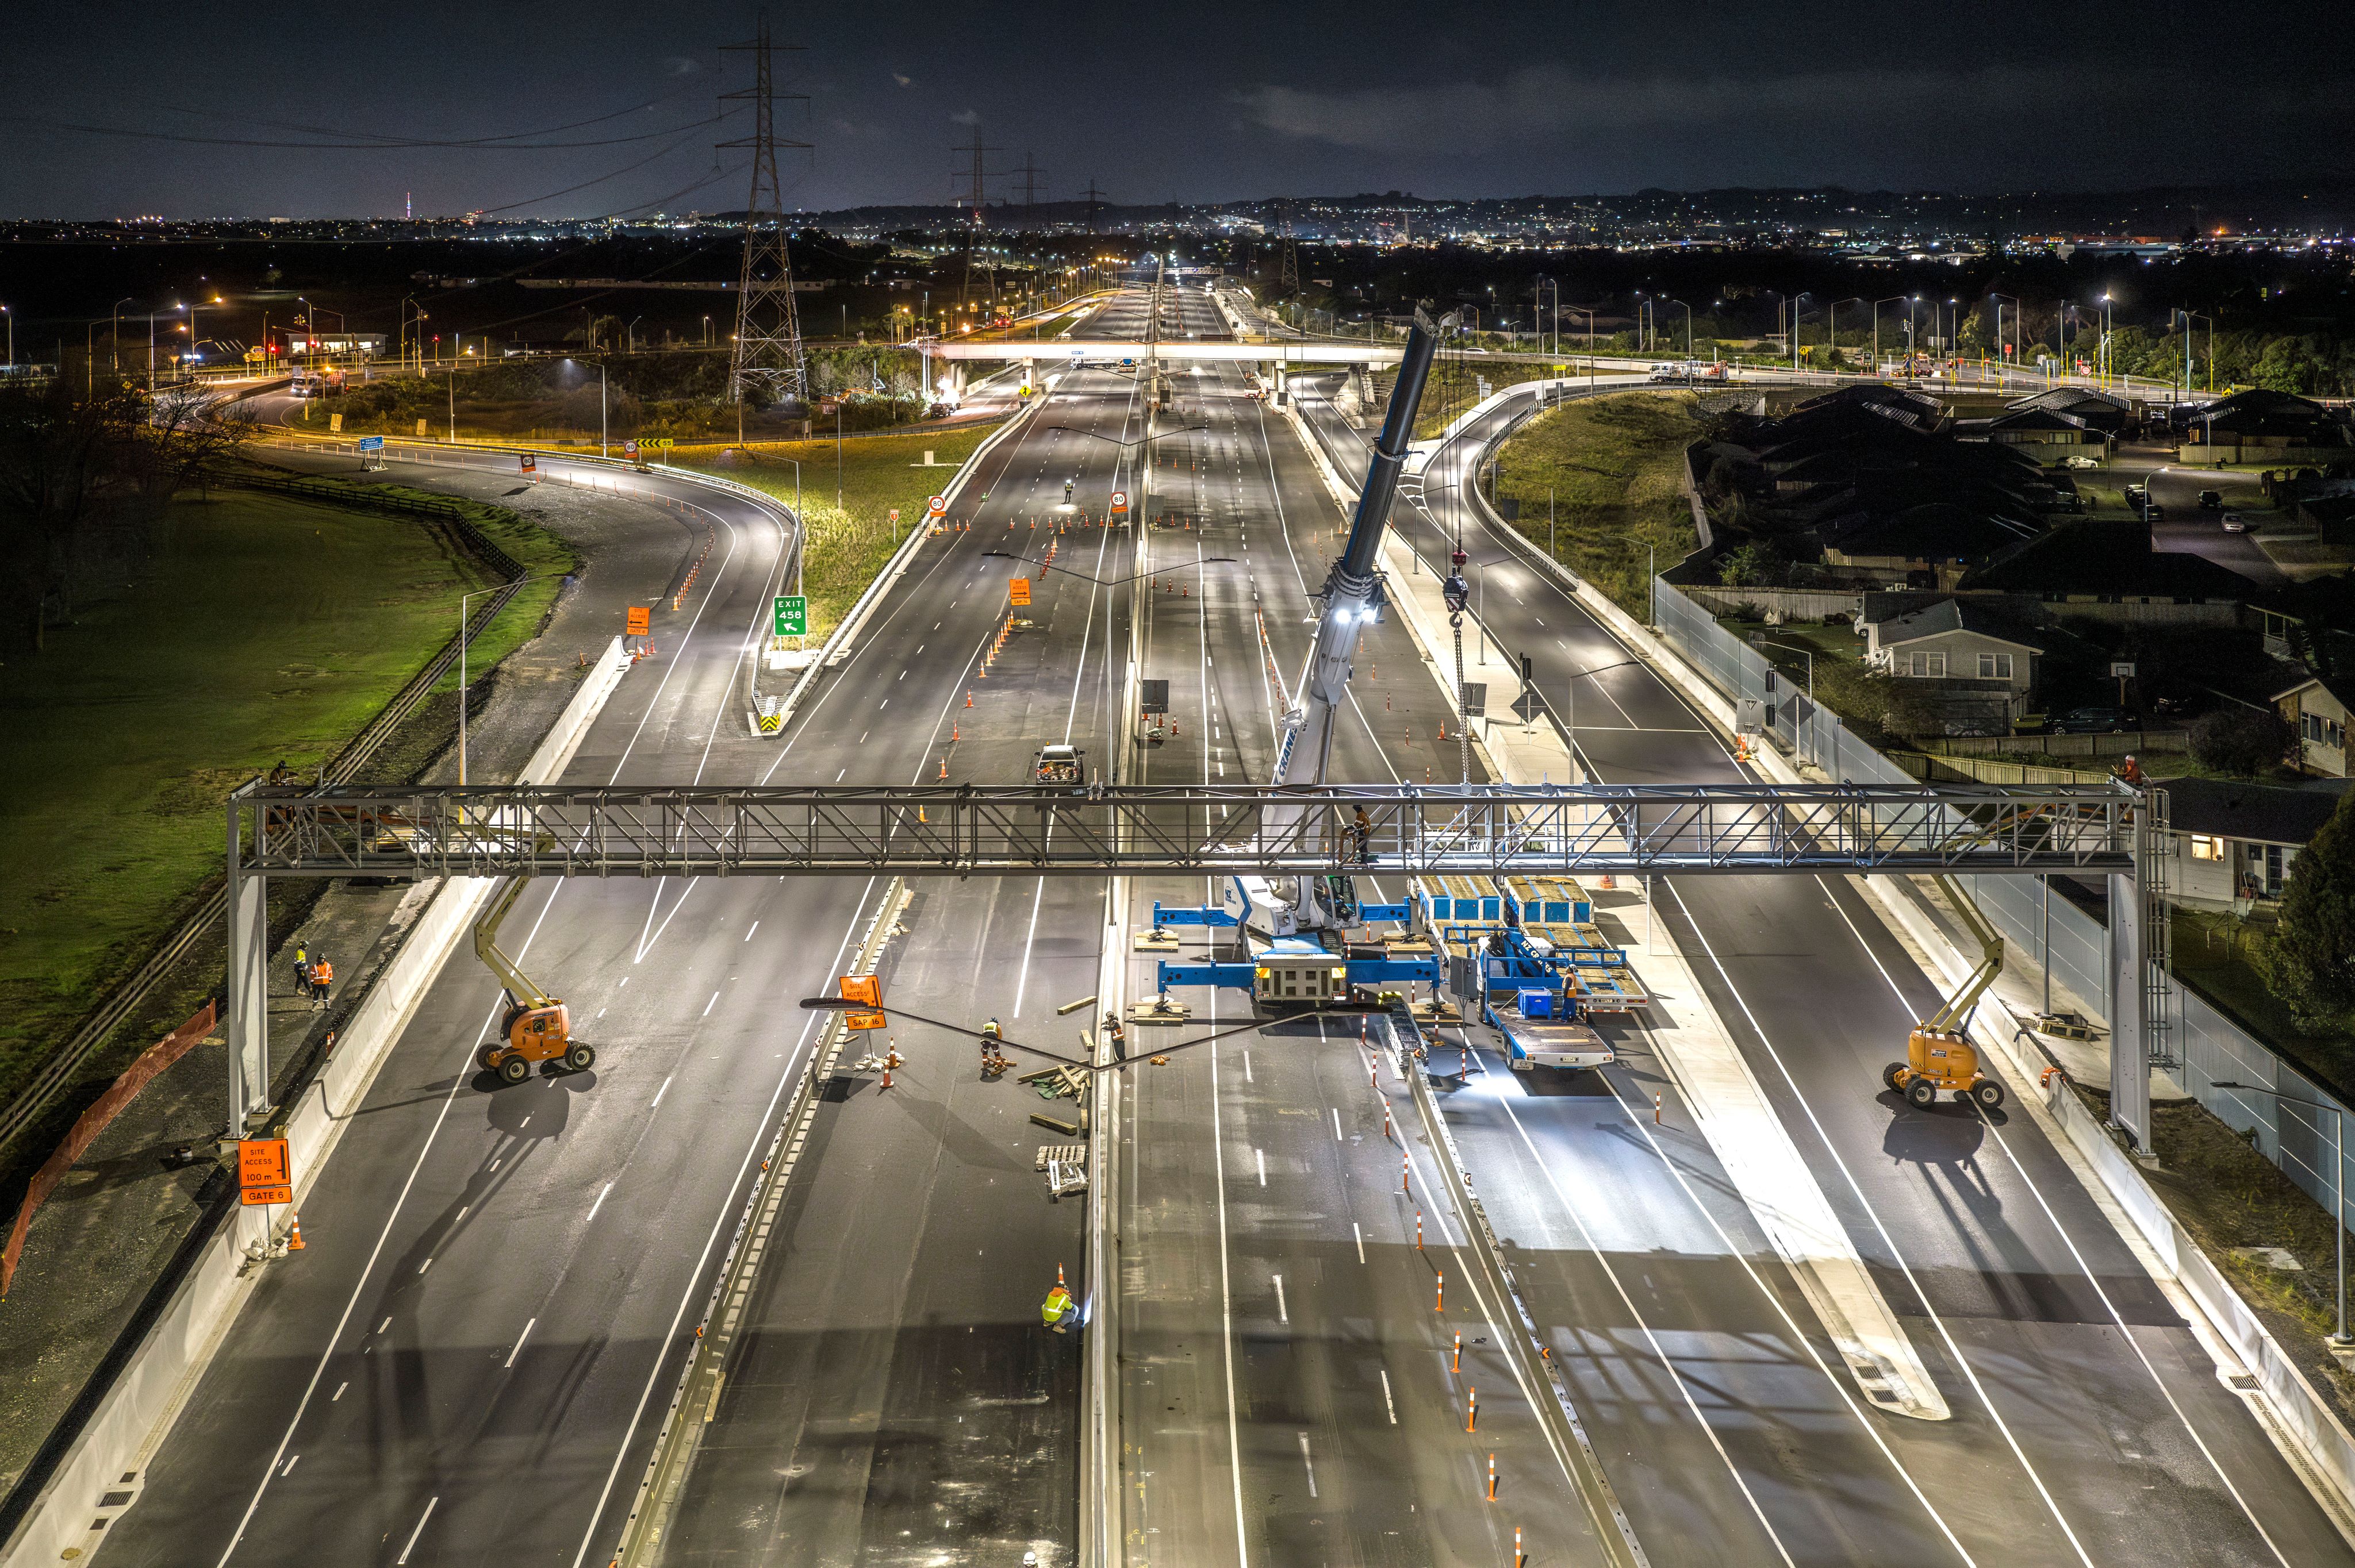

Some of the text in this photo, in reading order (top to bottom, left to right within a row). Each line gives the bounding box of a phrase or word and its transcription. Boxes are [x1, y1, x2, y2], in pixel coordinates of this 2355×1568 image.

[779, 611, 801, 619] 458
[1225, 889, 1232, 899] NZ
[1521, 940, 1553, 973] NZ CRES
[247, 1173, 262, 1181] 100
[249, 1191, 284, 1200] GATE 6
